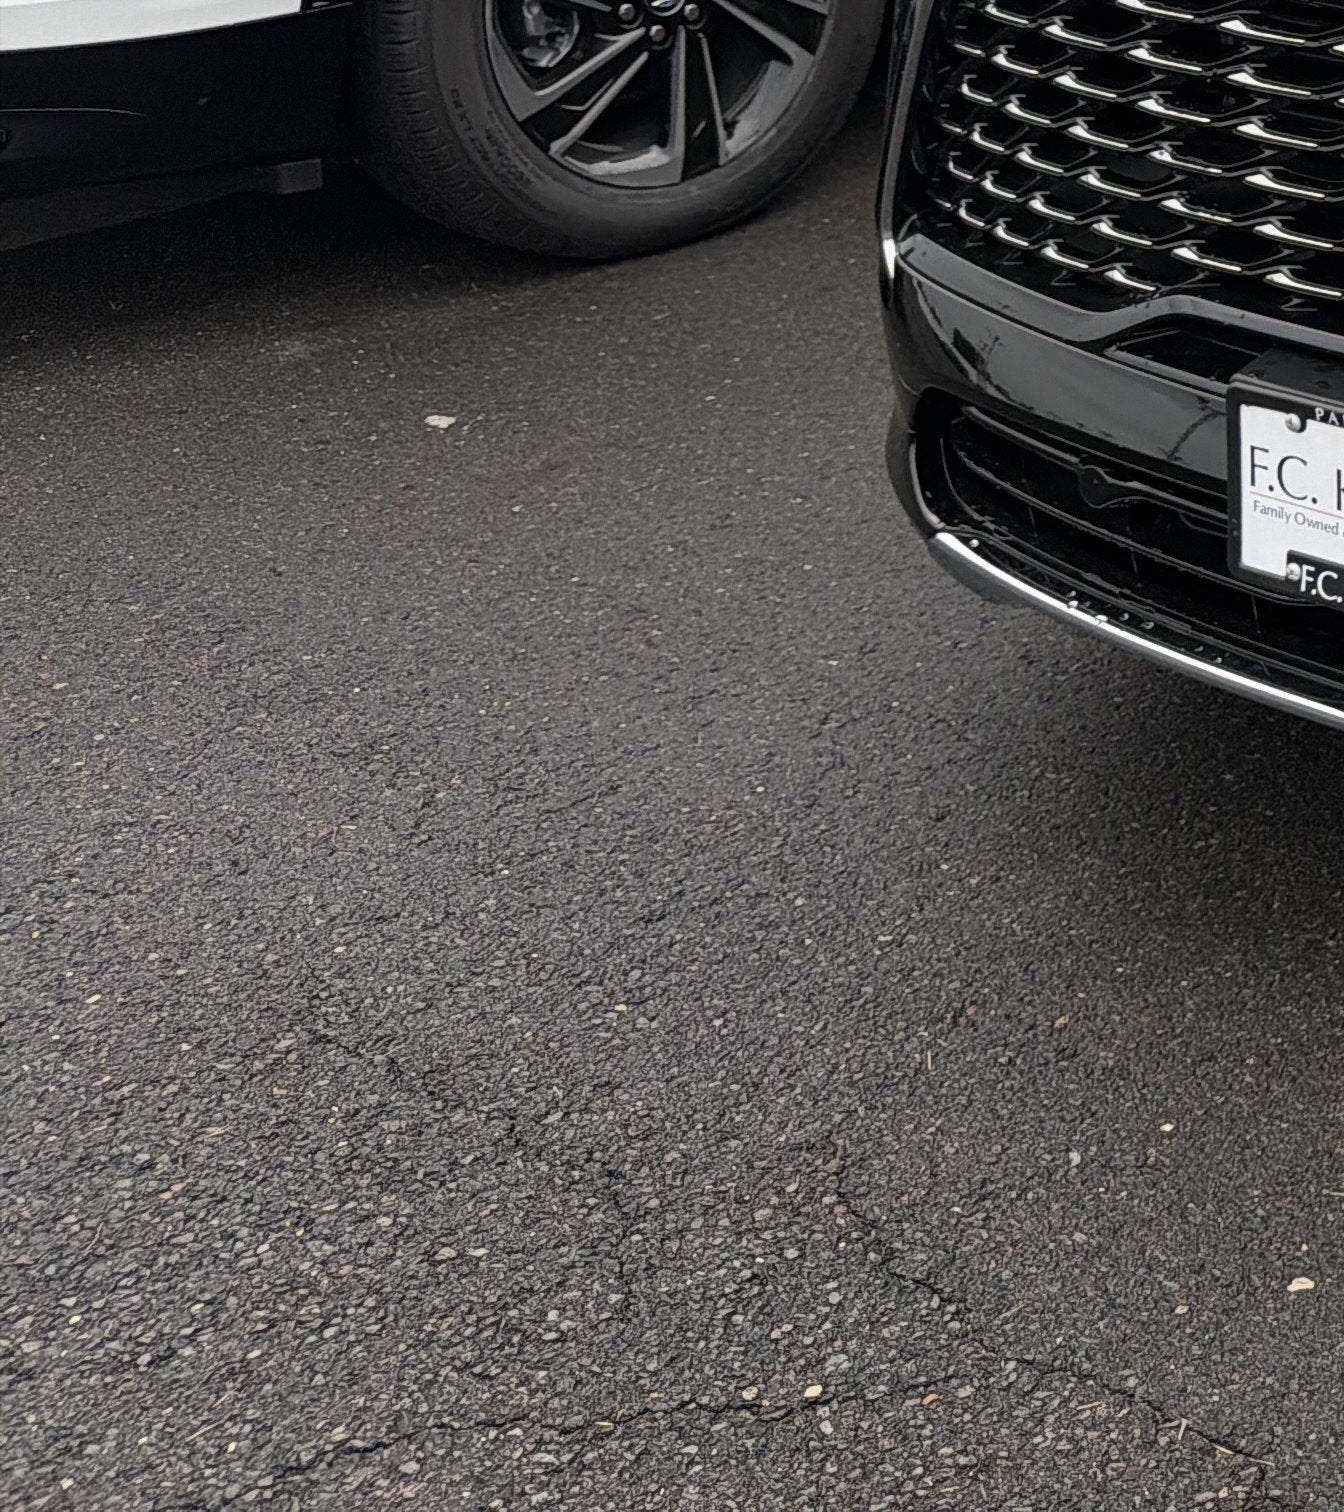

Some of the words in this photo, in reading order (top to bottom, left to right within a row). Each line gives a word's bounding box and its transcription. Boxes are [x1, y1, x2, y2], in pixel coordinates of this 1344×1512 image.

[1249, 444, 1318, 505] F.C.
[1253, 499, 1292, 523] Family
[1294, 511, 1339, 535] Owned
[1300, 564, 1343, 603] F.C.
